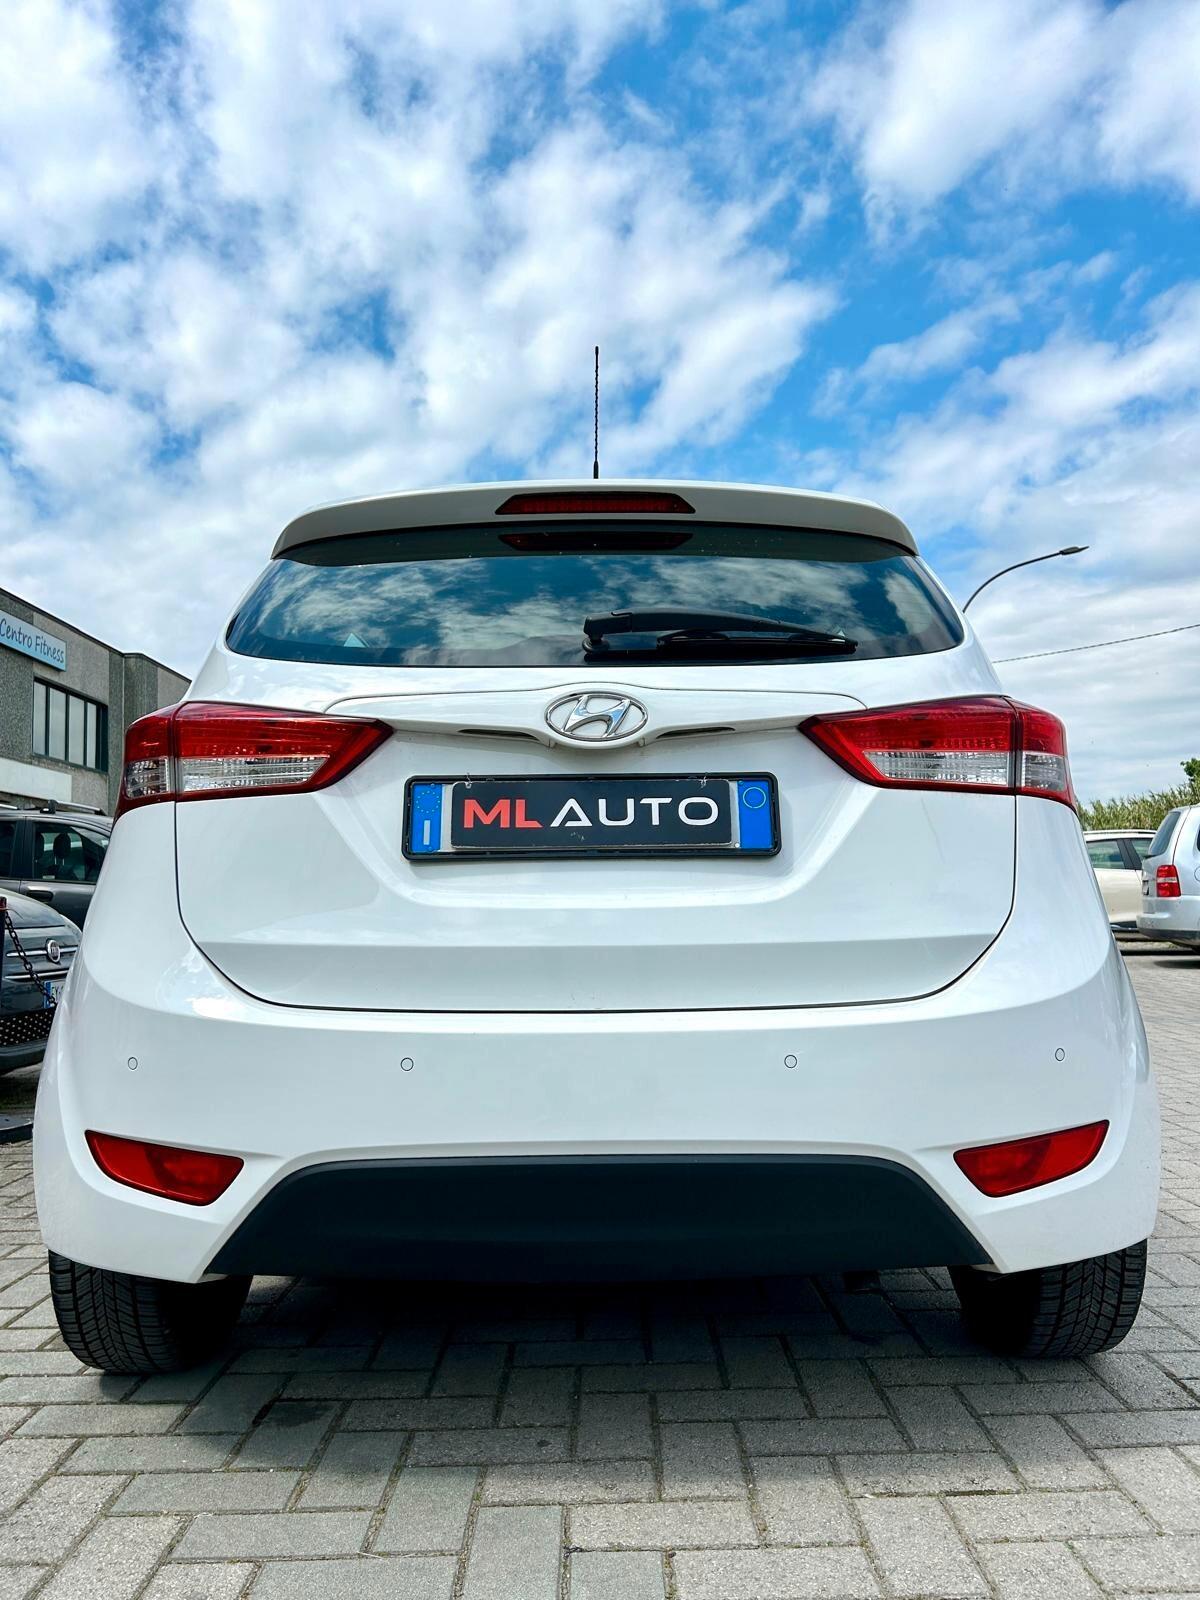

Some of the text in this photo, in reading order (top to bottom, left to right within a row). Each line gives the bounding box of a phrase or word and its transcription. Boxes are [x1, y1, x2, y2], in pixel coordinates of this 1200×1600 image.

[0, 618, 65, 664] Centro Fitness
[464, 797, 719, 828] ML AUTO
